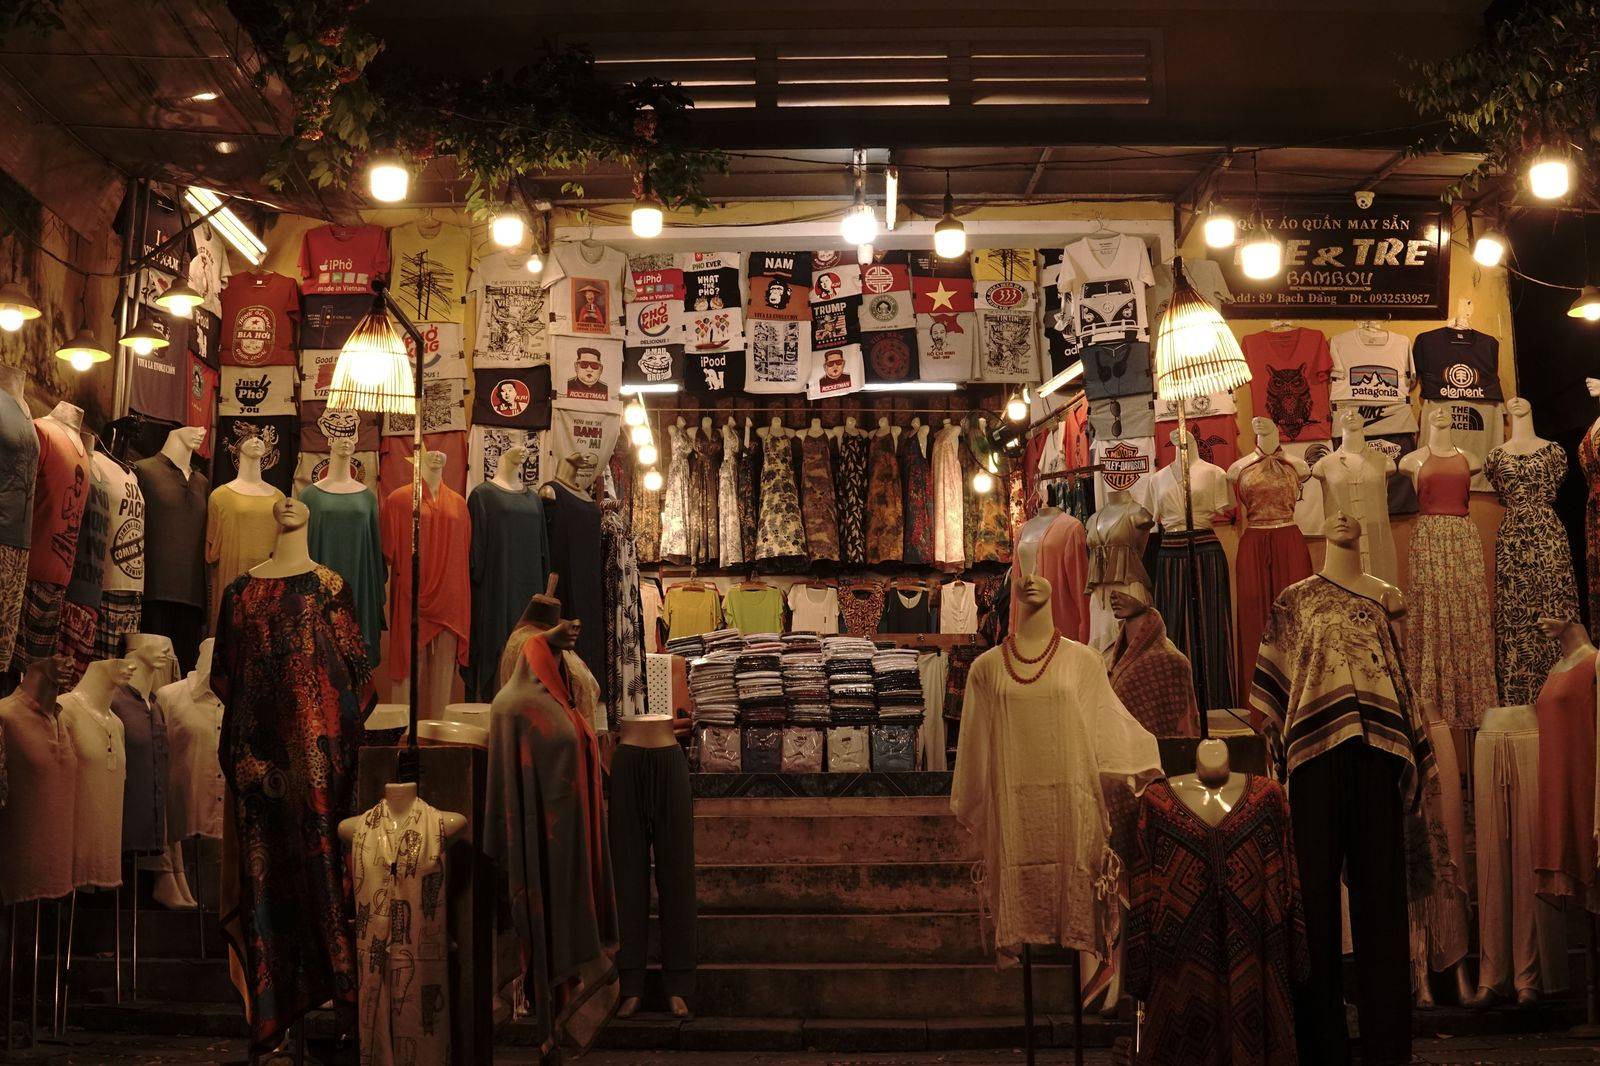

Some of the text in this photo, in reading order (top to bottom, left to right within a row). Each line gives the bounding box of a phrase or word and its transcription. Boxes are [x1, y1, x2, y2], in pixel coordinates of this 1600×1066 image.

[1279, 215, 1298, 230] ÁO
[1347, 219, 1378, 230] MAY
[1312, 245, 1345, 267] &
[1352, 237, 1431, 266] TRE
[706, 259, 722, 268] EVER
[764, 257, 794, 270] NAM
[697, 274, 720, 284] WHAT
[1286, 270, 1373, 286] BAMBOU
[317, 284, 367, 292] made in Vietnam
[502, 285, 530, 295] TINTIN
[1259, 293, 1272, 303] 89
[1369, 293, 1430, 304] 0932533957
[813, 302, 847, 315] TRUMP
[641, 314, 669, 331] KING
[315, 355, 333, 365] Good
[700, 355, 726, 368] iPood
[235, 378, 260, 388] Just
[1352, 387, 1398, 398] patagonia
[1439, 384, 1485, 399] element
[1358, 405, 1388, 419] NIKE
[1451, 414, 1469, 422] RTH
[1110, 446, 1134, 458] MOTOR
[1107, 473, 1135, 487] CYCLES
[125, 482, 141, 501] SIX
